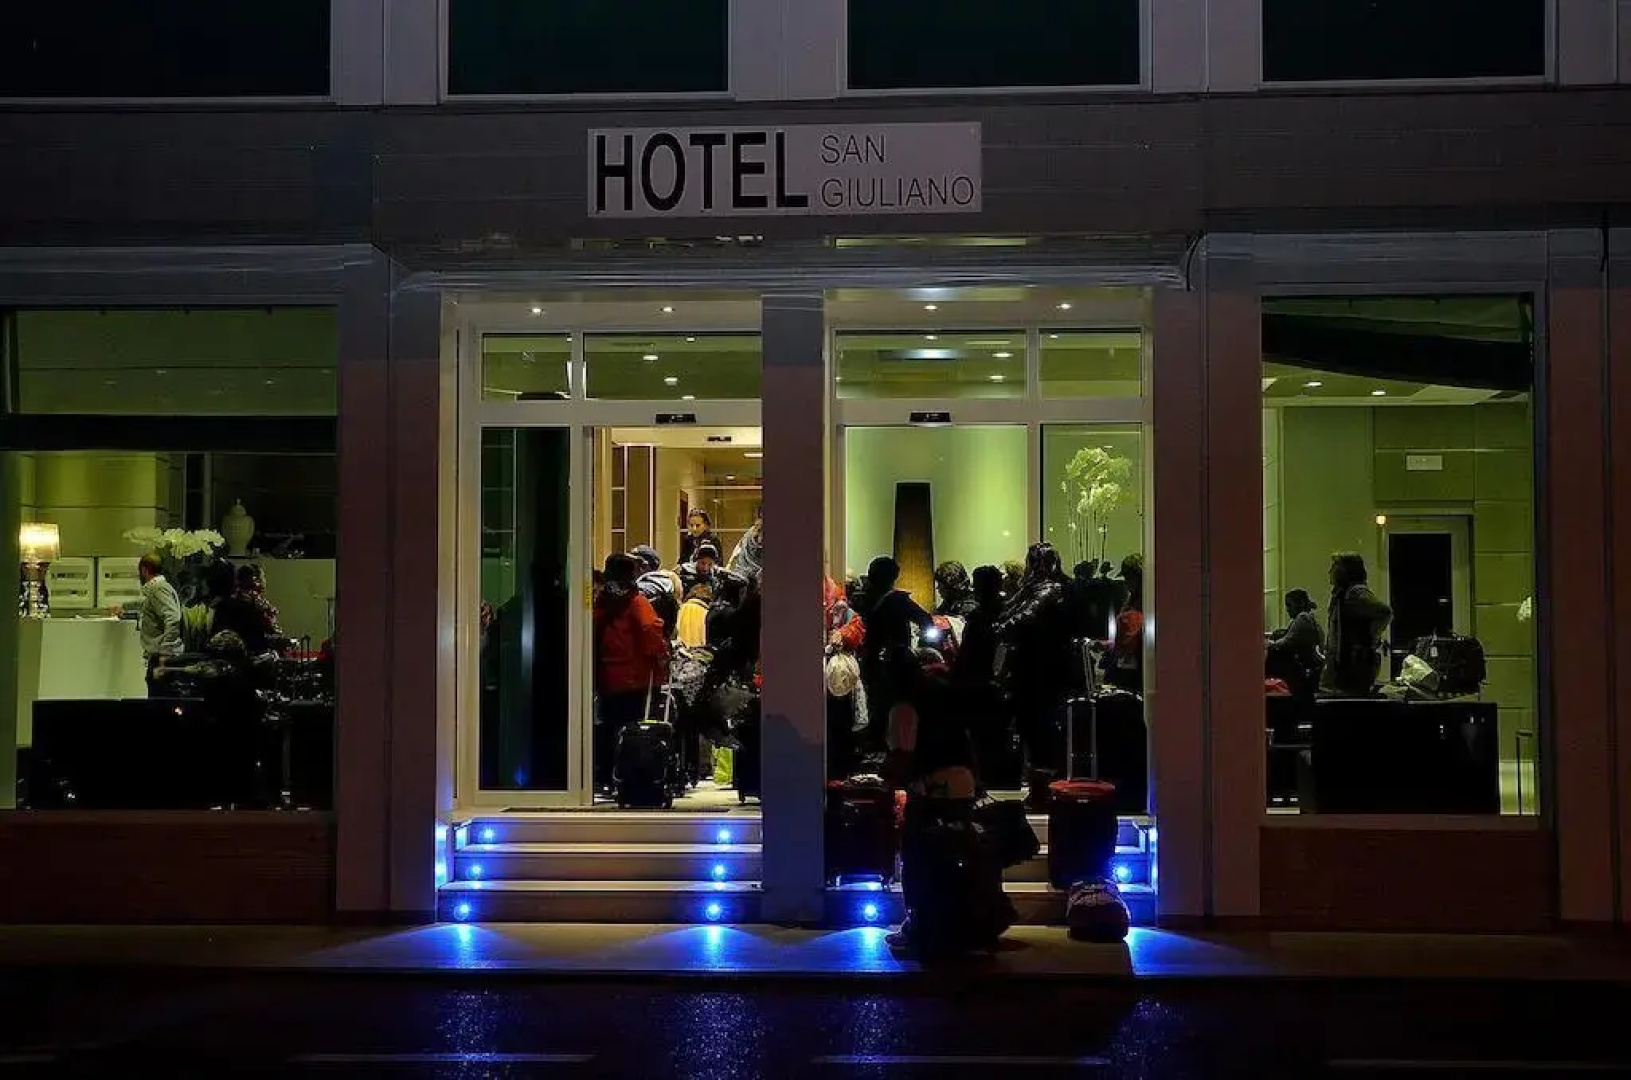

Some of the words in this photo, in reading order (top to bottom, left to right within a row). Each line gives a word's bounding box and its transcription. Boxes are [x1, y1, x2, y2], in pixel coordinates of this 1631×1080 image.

[821, 134, 885, 164] SAN
[595, 132, 809, 211] HOTEL
[821, 176, 974, 208] GIULIANO
